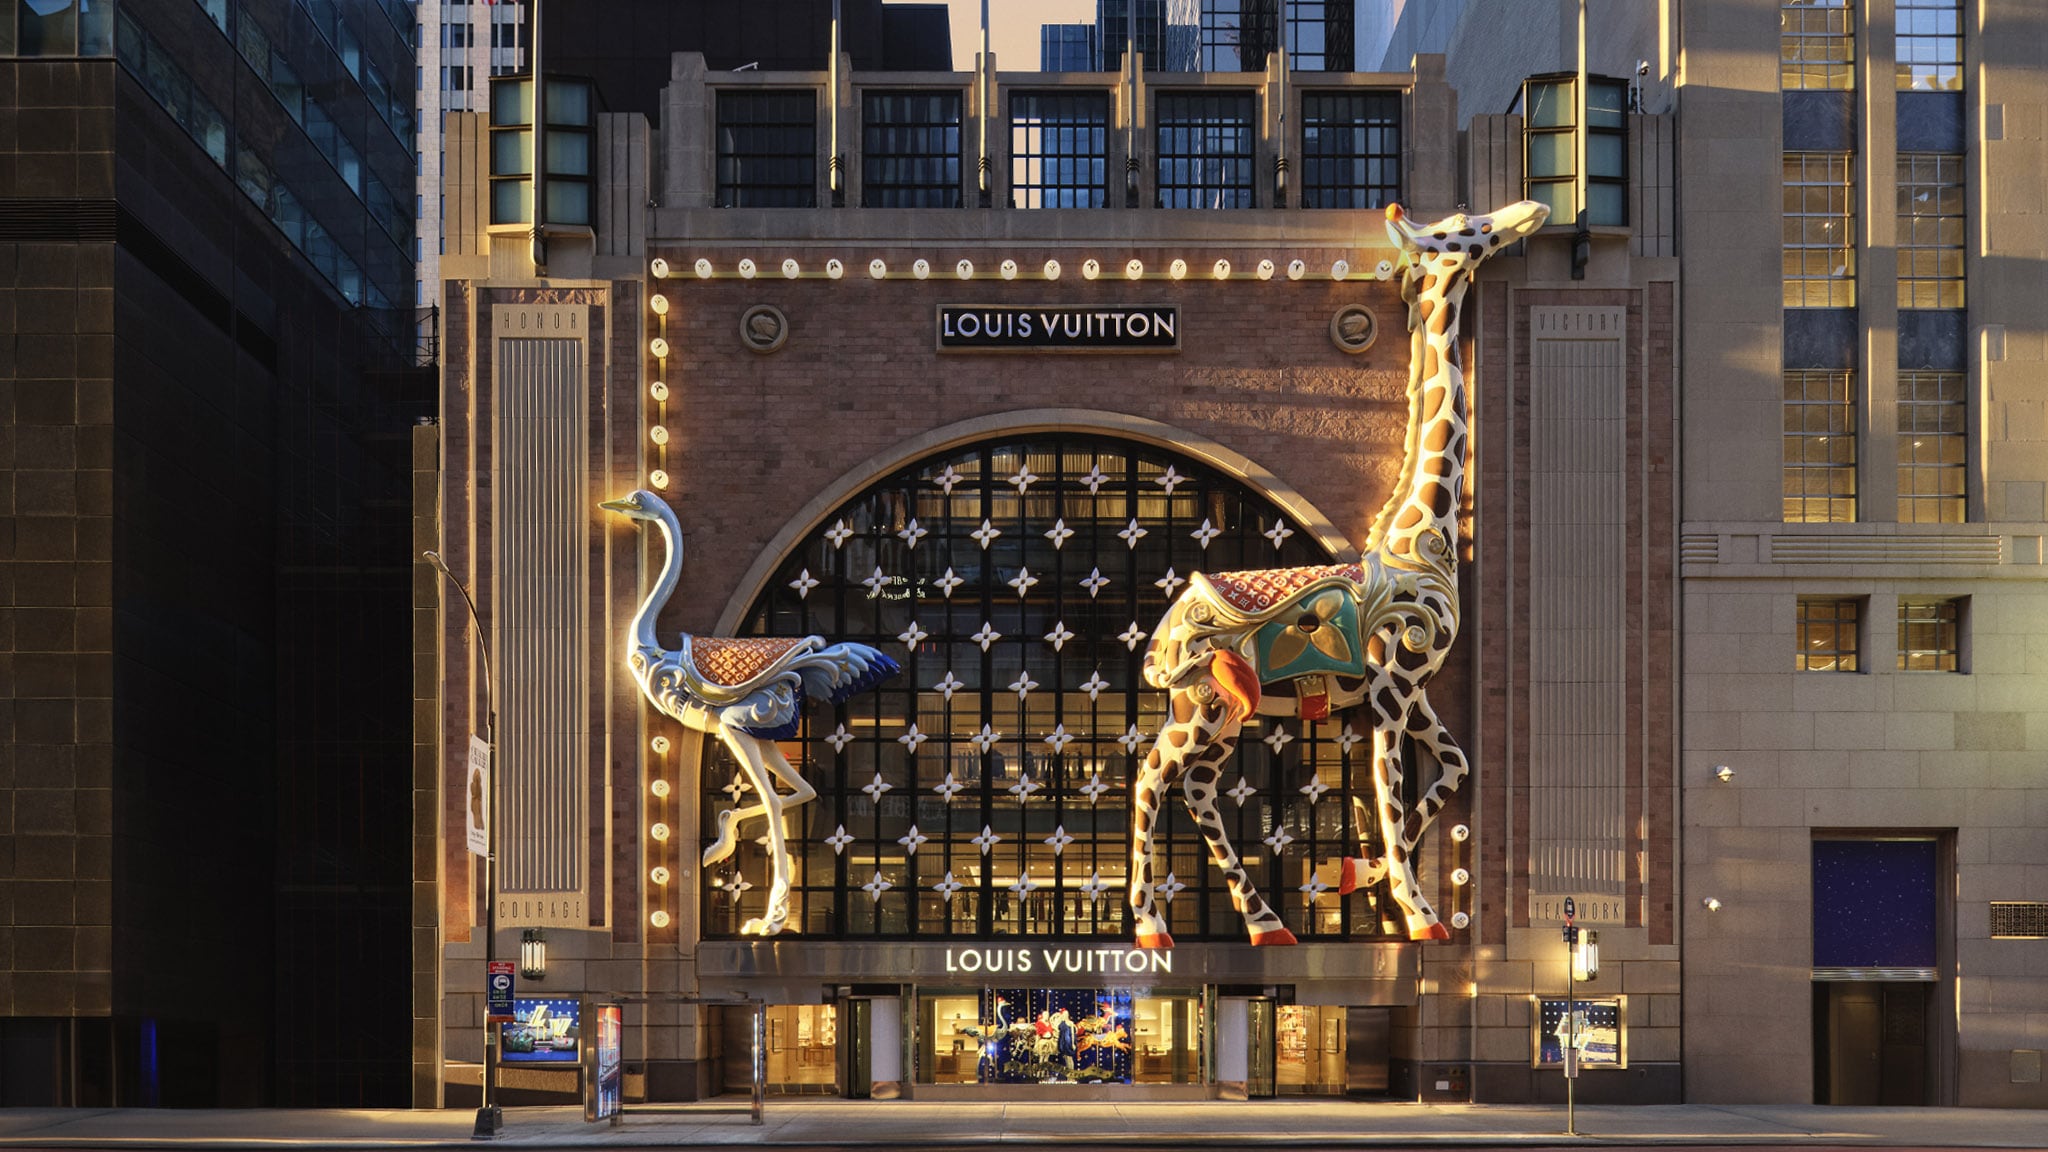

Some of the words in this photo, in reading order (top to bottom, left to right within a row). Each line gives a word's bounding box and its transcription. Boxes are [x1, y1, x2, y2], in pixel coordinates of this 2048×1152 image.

[504, 311, 577, 329] HONOR
[943, 312, 1033, 338] LOUIS
[1040, 312, 1175, 339] VUITTON
[1539, 313, 1619, 331] VICTORY
[499, 901, 580, 919] COURAGE
[1535, 902, 1620, 920] TEAWORK
[945, 949, 1032, 972] LOUIS
[1043, 949, 1172, 973] VUITTON
